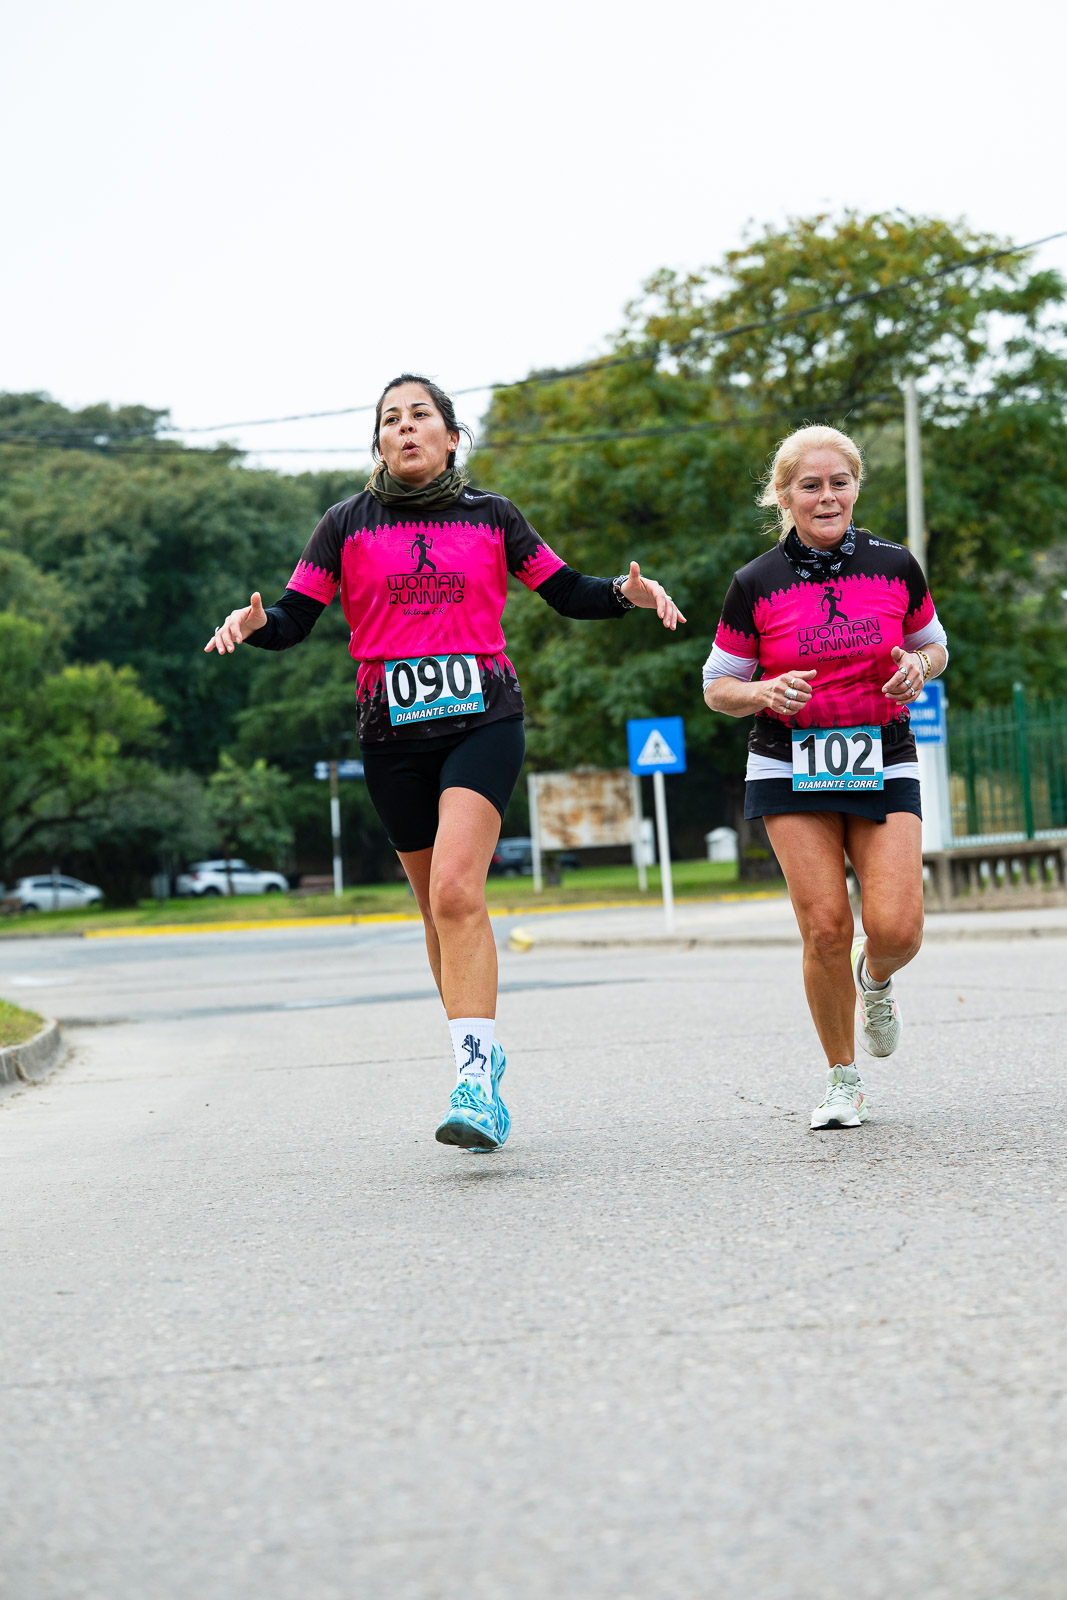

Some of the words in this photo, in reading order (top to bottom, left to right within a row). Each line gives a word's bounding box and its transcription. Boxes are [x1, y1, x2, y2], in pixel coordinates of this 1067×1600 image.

[387, 575, 465, 591] WOMAN
[389, 589, 465, 606] RUNNING
[798, 618, 880, 643] WOMAN
[798, 632, 883, 657] RUNNING
[391, 654, 473, 709] 090
[395, 705, 445, 723] DIAMANTE
[446, 701, 479, 714] CORRE
[799, 731, 876, 777] 102
[797, 779, 846, 790] DIAMANTE
[847, 779, 879, 789] CORRE
